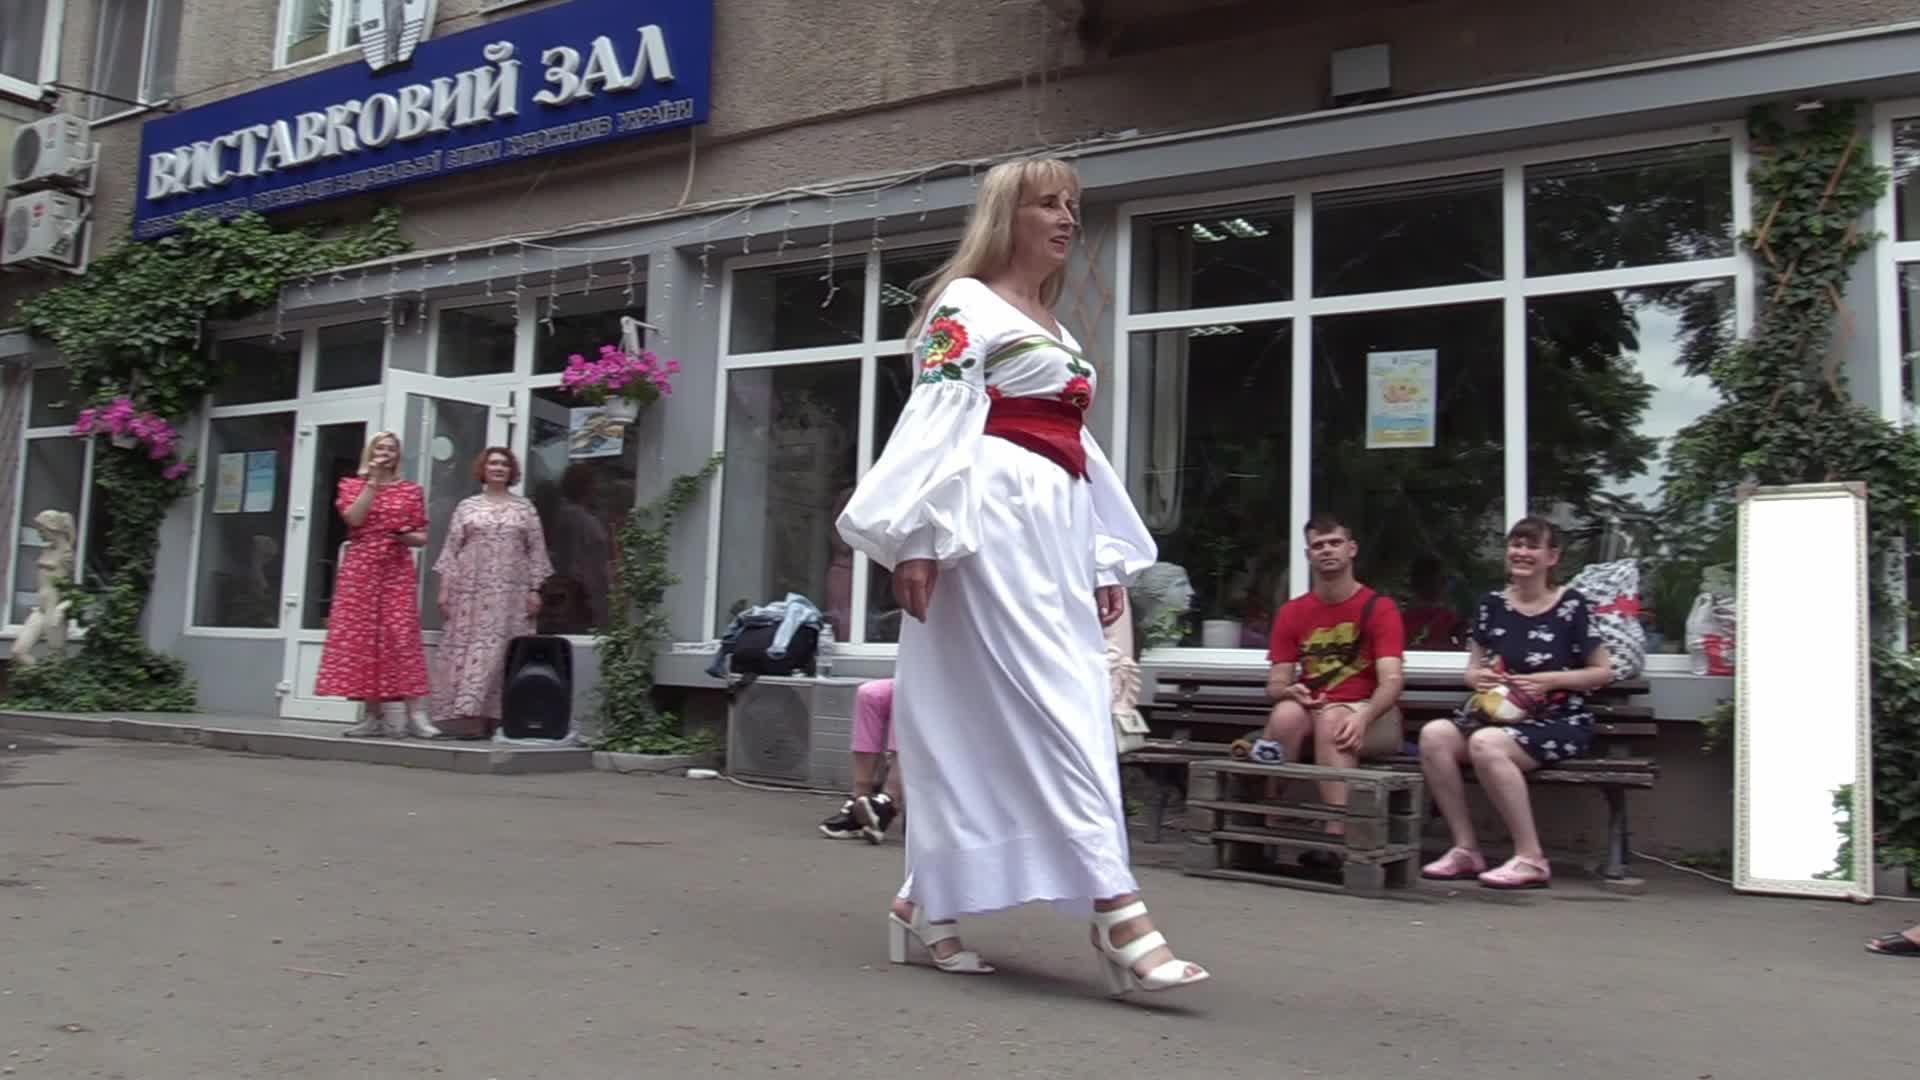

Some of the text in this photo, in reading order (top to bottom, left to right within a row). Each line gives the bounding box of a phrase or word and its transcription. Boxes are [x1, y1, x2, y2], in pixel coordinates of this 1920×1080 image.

[145, 24, 675, 200] ВИСТАВКОВИЙ ЗАЛ
[616, 97, 694, 133] УКРАЇНИ
